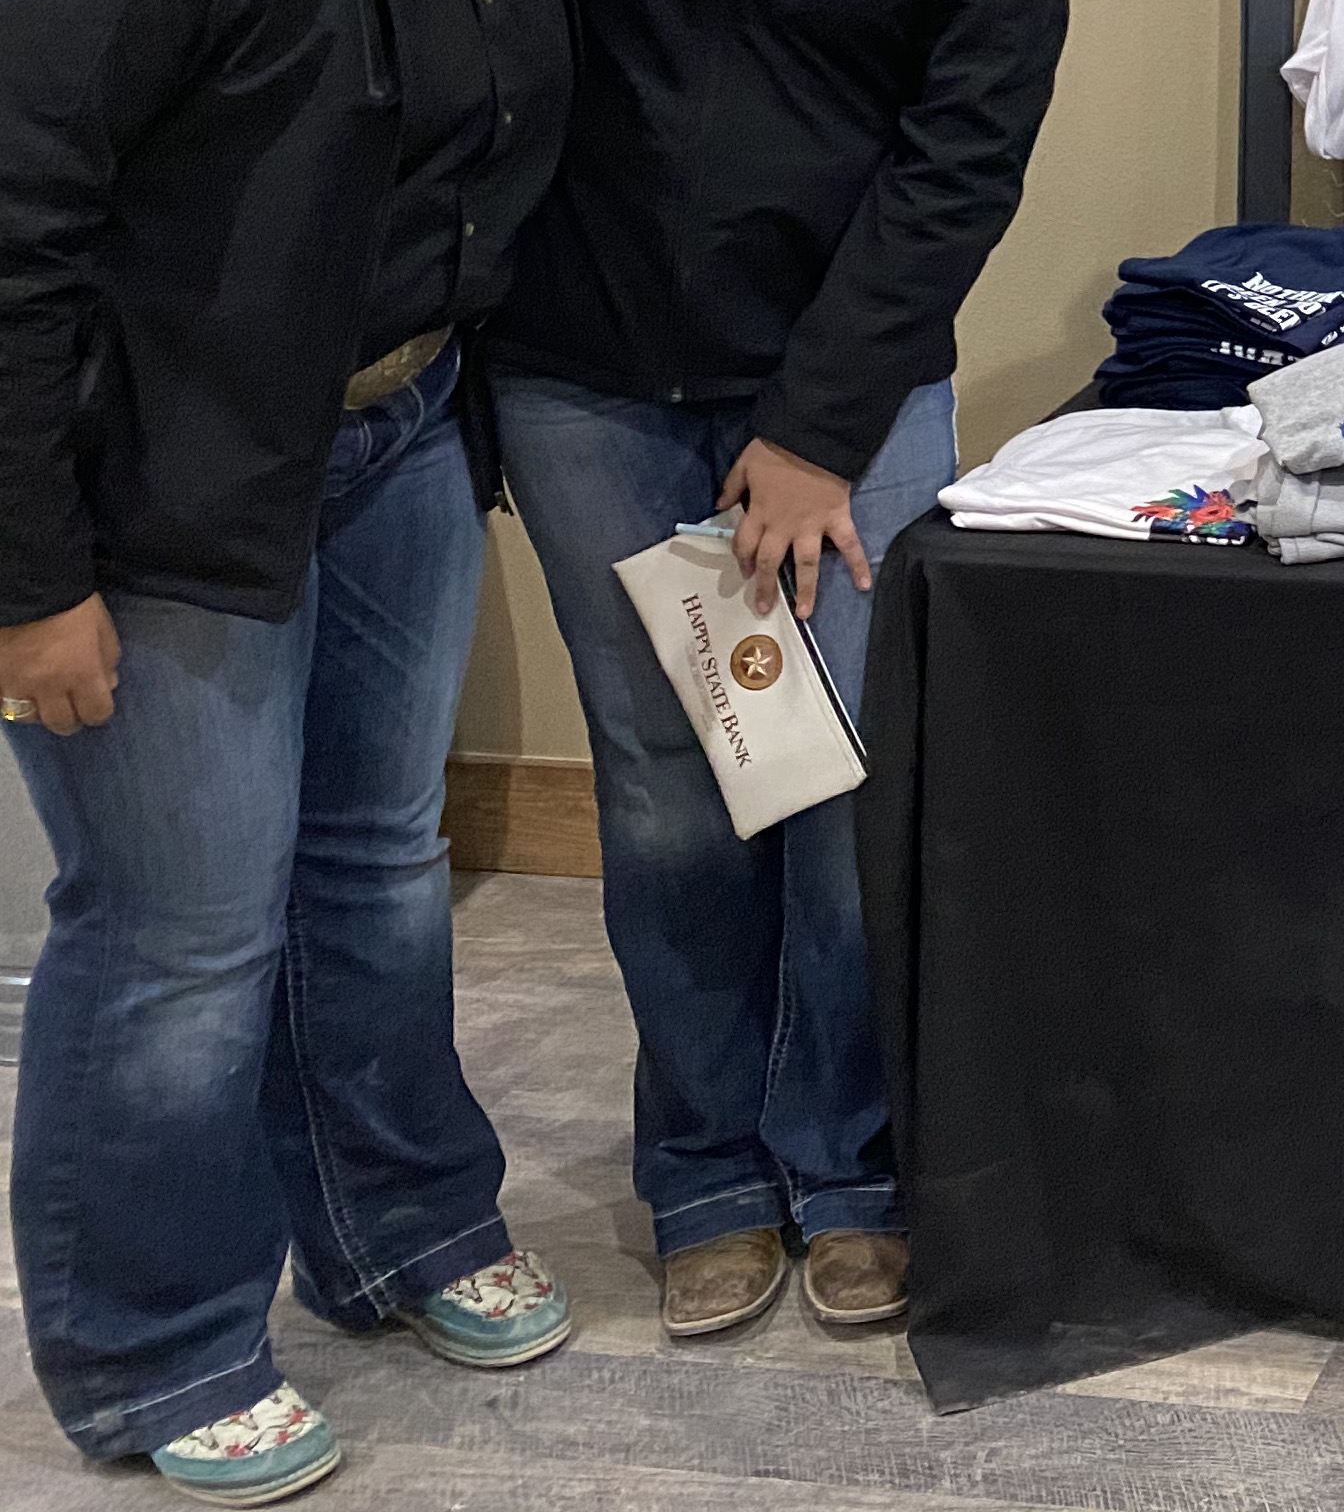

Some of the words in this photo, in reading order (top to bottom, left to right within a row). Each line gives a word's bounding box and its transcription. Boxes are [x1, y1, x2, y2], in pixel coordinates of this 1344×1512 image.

[681, 592, 712, 655] HAPPY
[702, 657, 733, 714] STATE
[720, 714, 753, 769] BANK
